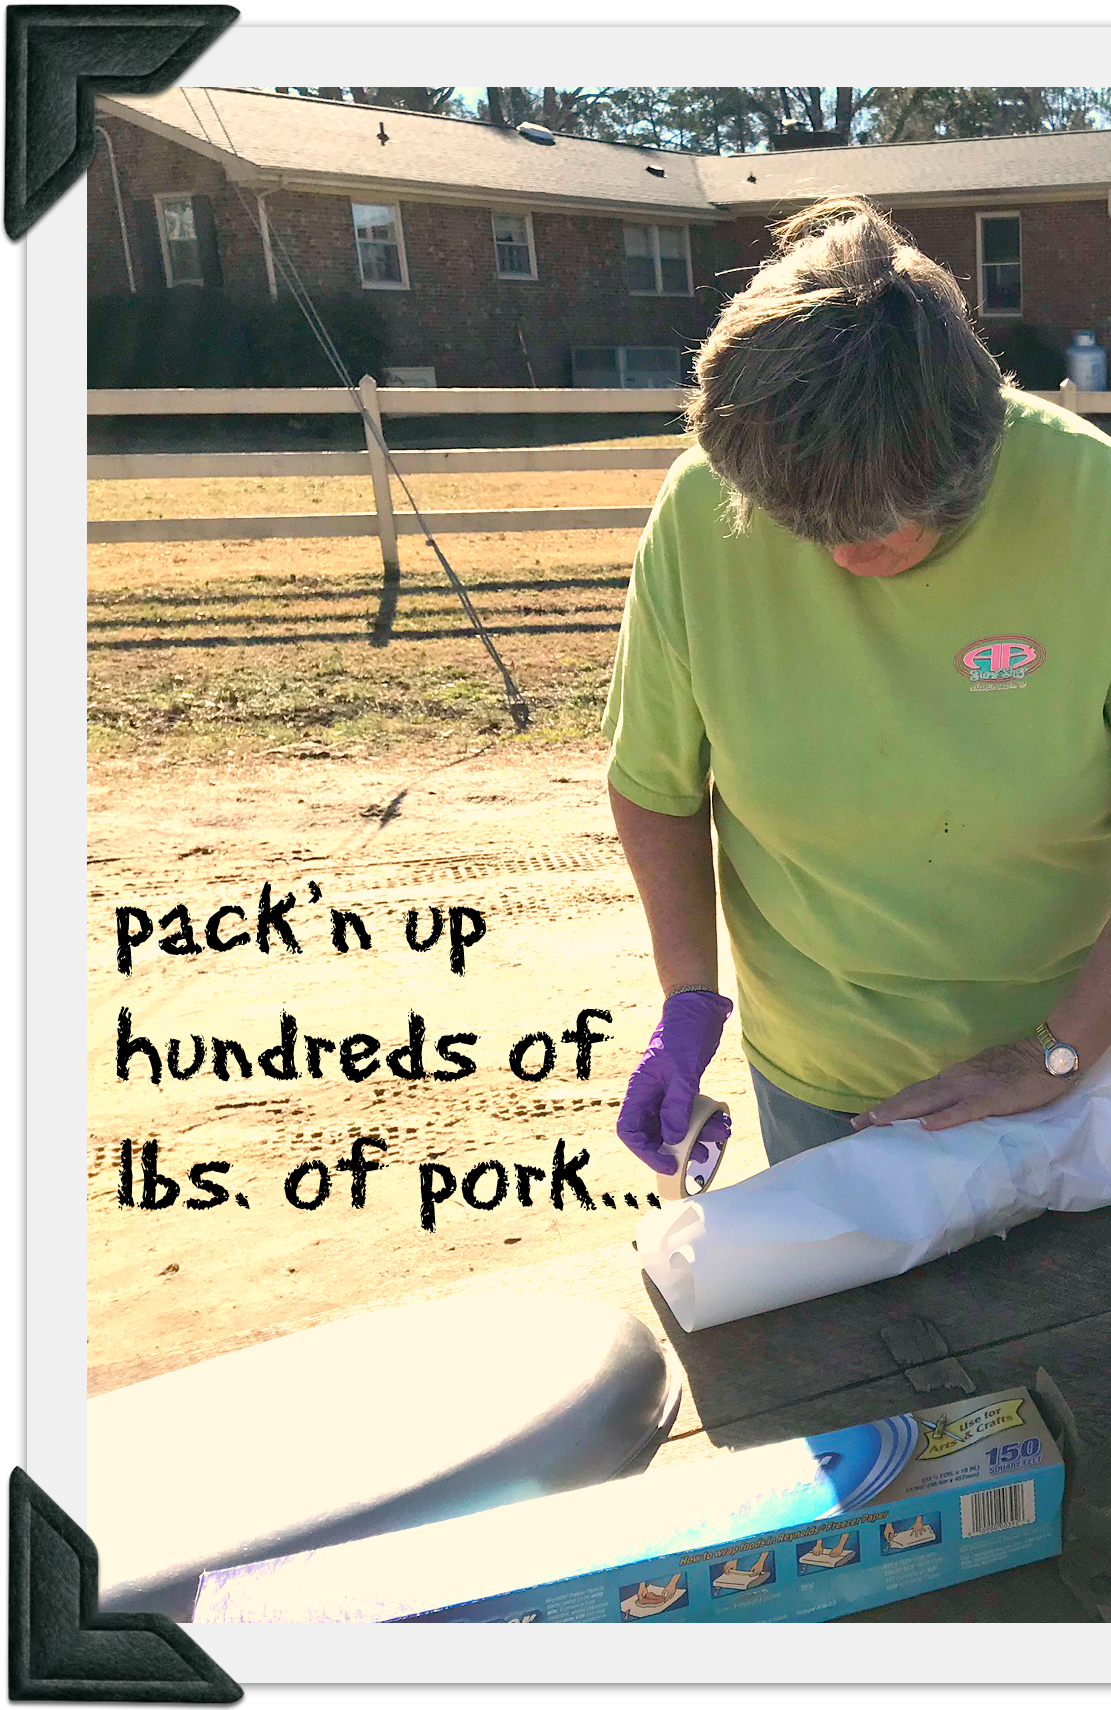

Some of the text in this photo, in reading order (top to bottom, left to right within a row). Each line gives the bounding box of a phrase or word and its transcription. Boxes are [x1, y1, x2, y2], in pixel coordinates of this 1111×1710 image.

[929, 1414, 1014, 1454] Arts & Crafts
[960, 1408, 1001, 1432] Use for
[985, 1438, 1040, 1466] 150
[989, 1460, 1022, 1474] SQUARE
[680, 1554, 701, 1567] How
[702, 1550, 712, 1561] to
[714, 1545, 740, 1560] wrap
[740, 1537, 766, 1552] foods
[766, 1534, 776, 1545] in
[825, 1516, 861, 1532] Freezer
[861, 1510, 889, 1525] Paper
